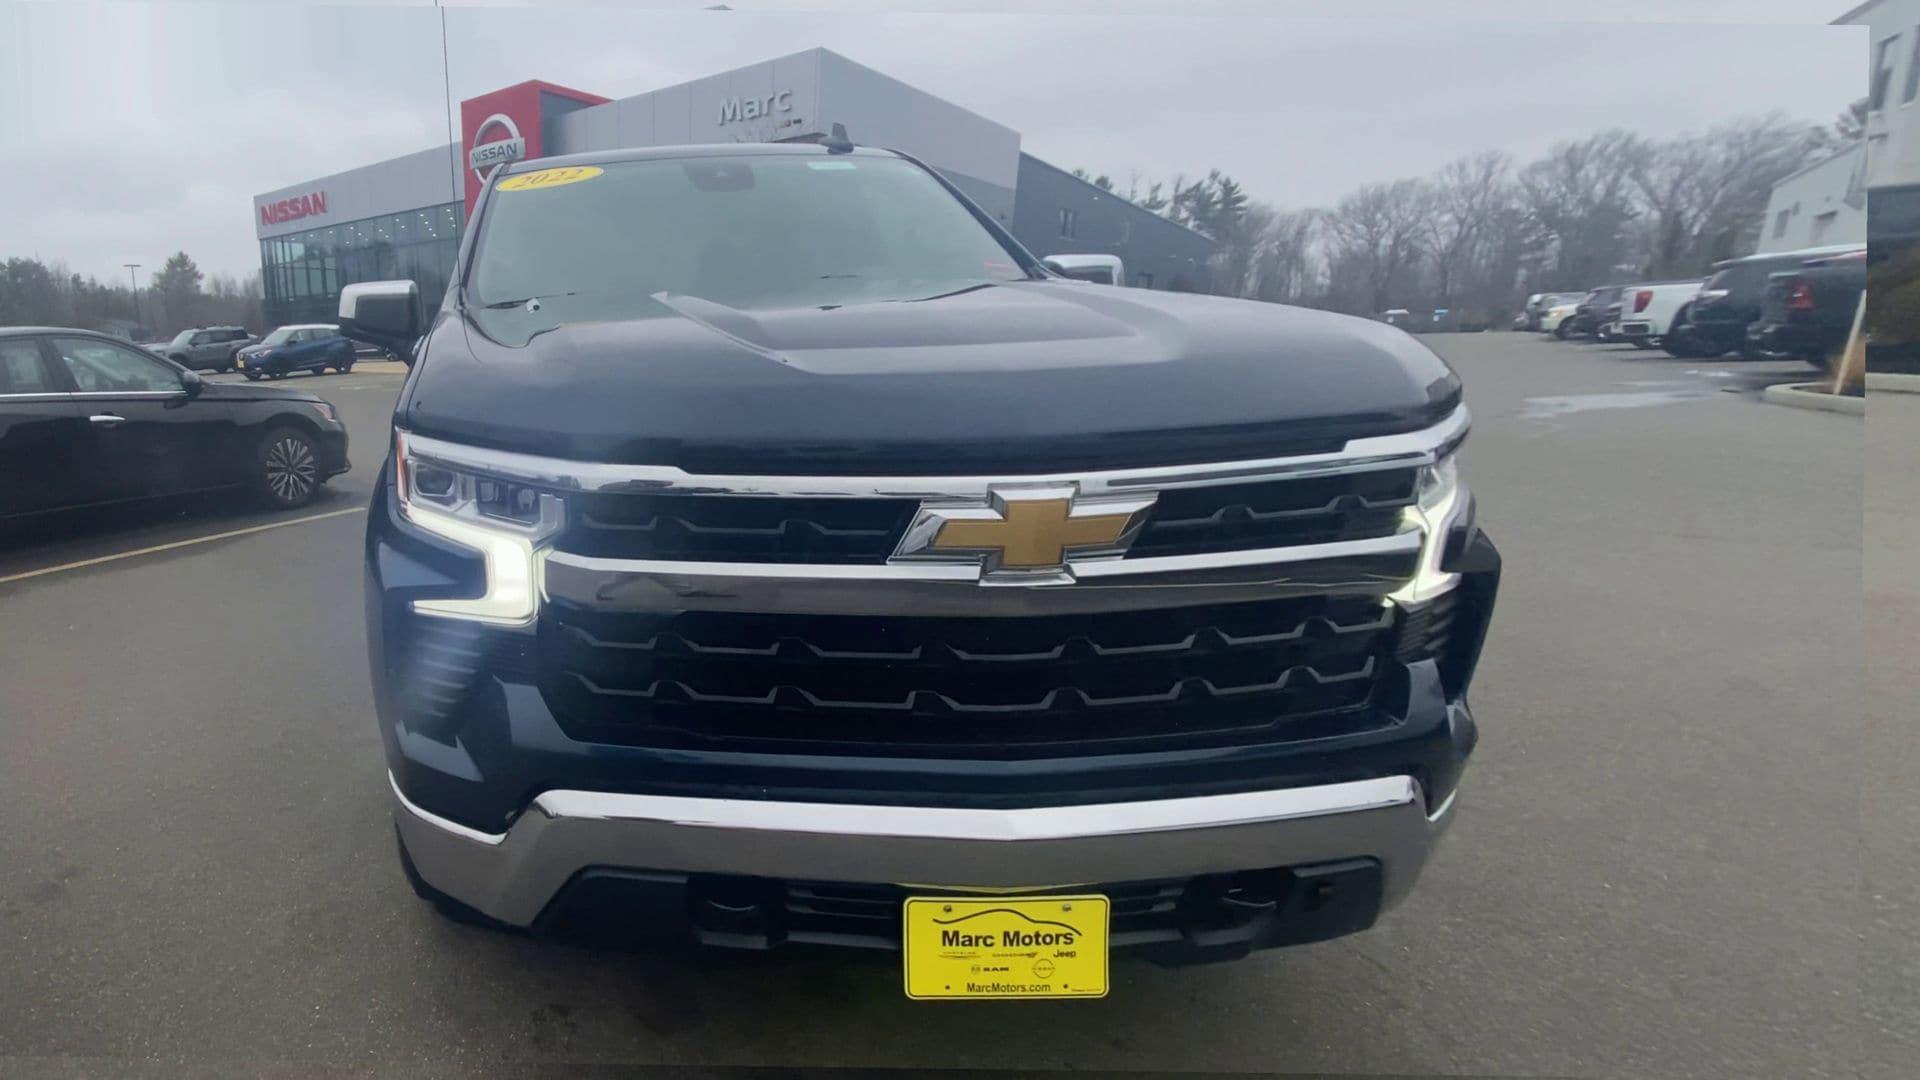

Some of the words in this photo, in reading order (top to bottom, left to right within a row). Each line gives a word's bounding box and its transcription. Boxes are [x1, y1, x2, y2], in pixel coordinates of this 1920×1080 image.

[719, 89, 792, 126] Marc
[472, 142, 518, 163] NISSAN
[511, 168, 585, 188] 2022
[261, 191, 328, 226] NISSAN
[942, 930, 995, 947] Marc
[1003, 931, 1074, 947] Motors
[1053, 949, 1076, 958] Jeep
[966, 983, 1051, 993] MarcMotors.com
